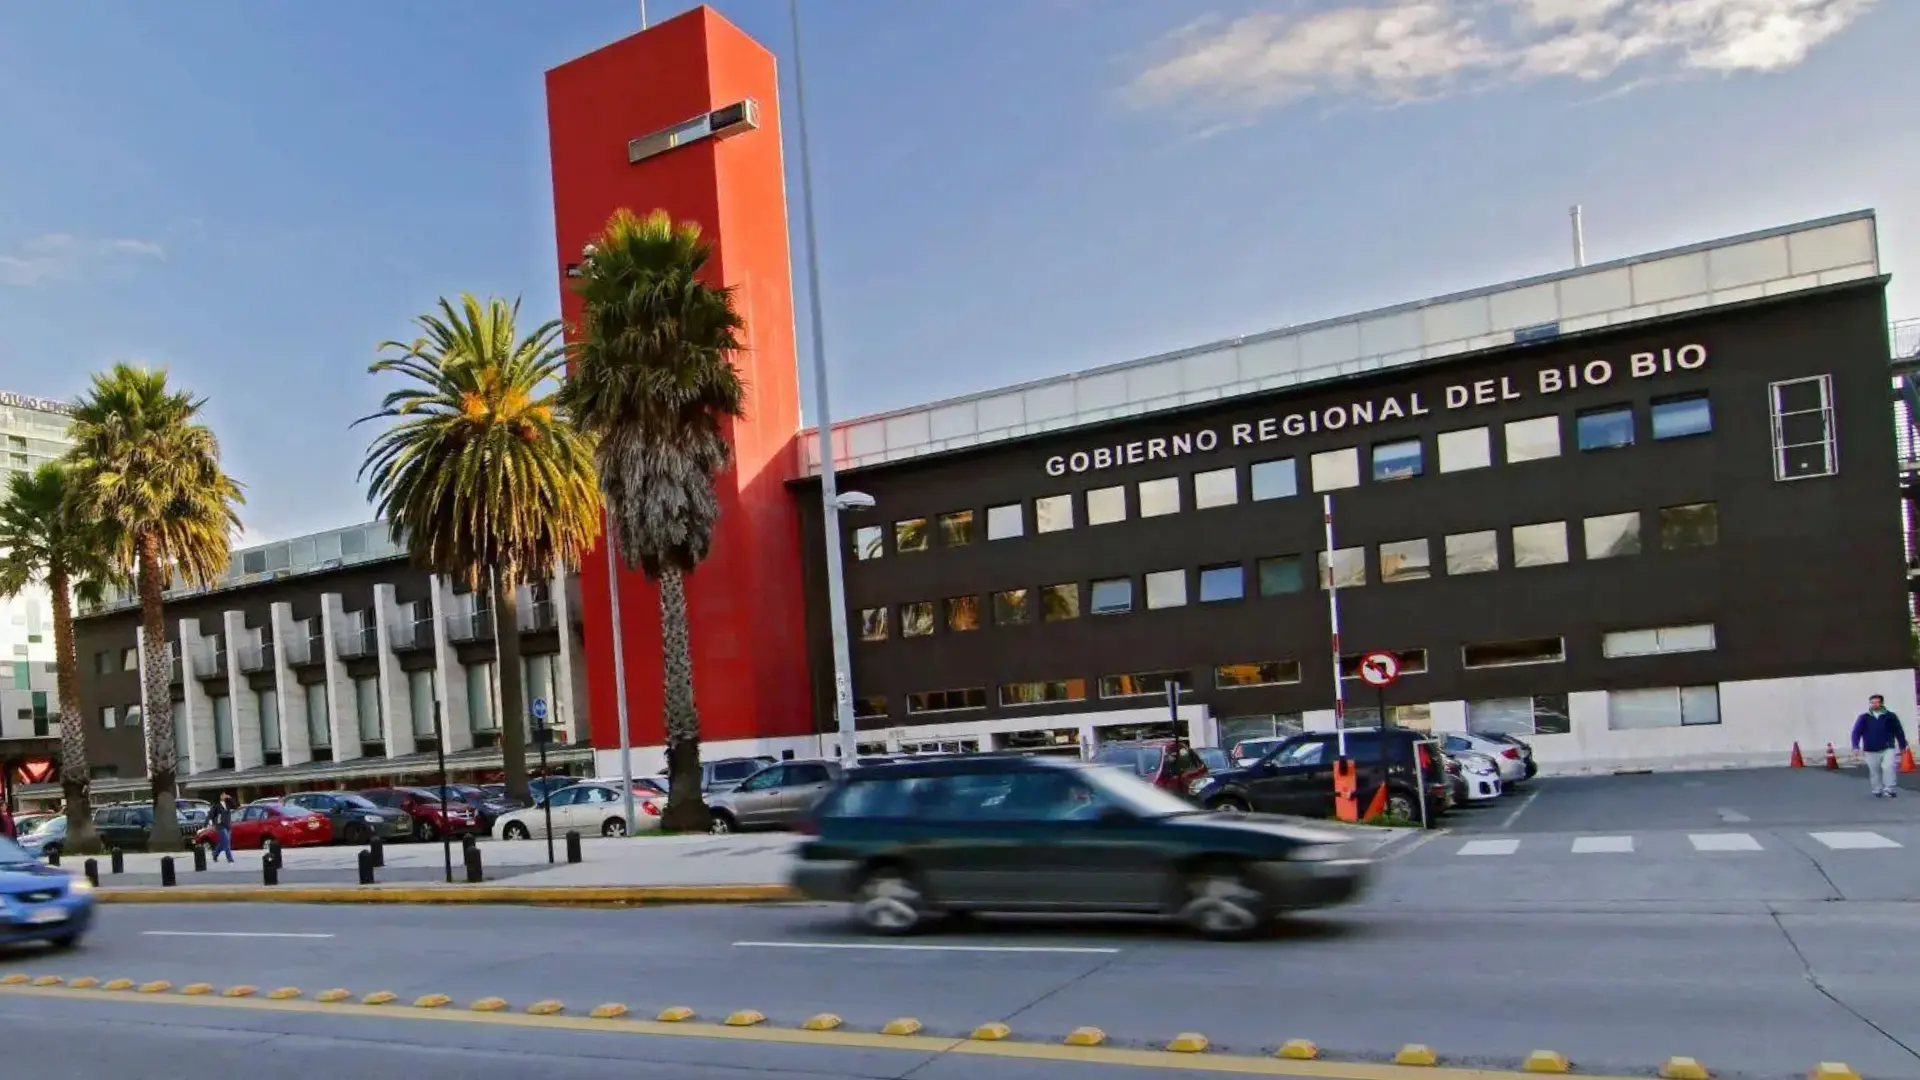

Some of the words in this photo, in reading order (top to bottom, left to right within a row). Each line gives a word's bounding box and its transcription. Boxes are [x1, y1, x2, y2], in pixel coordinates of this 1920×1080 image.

[1045, 429, 1217, 476] GOBIERNO
[1233, 393, 1429, 445] REGIONAL
[1447, 376, 1521, 409] DEL
[1539, 360, 1612, 394] BIO
[1631, 343, 1707, 378] BIO
